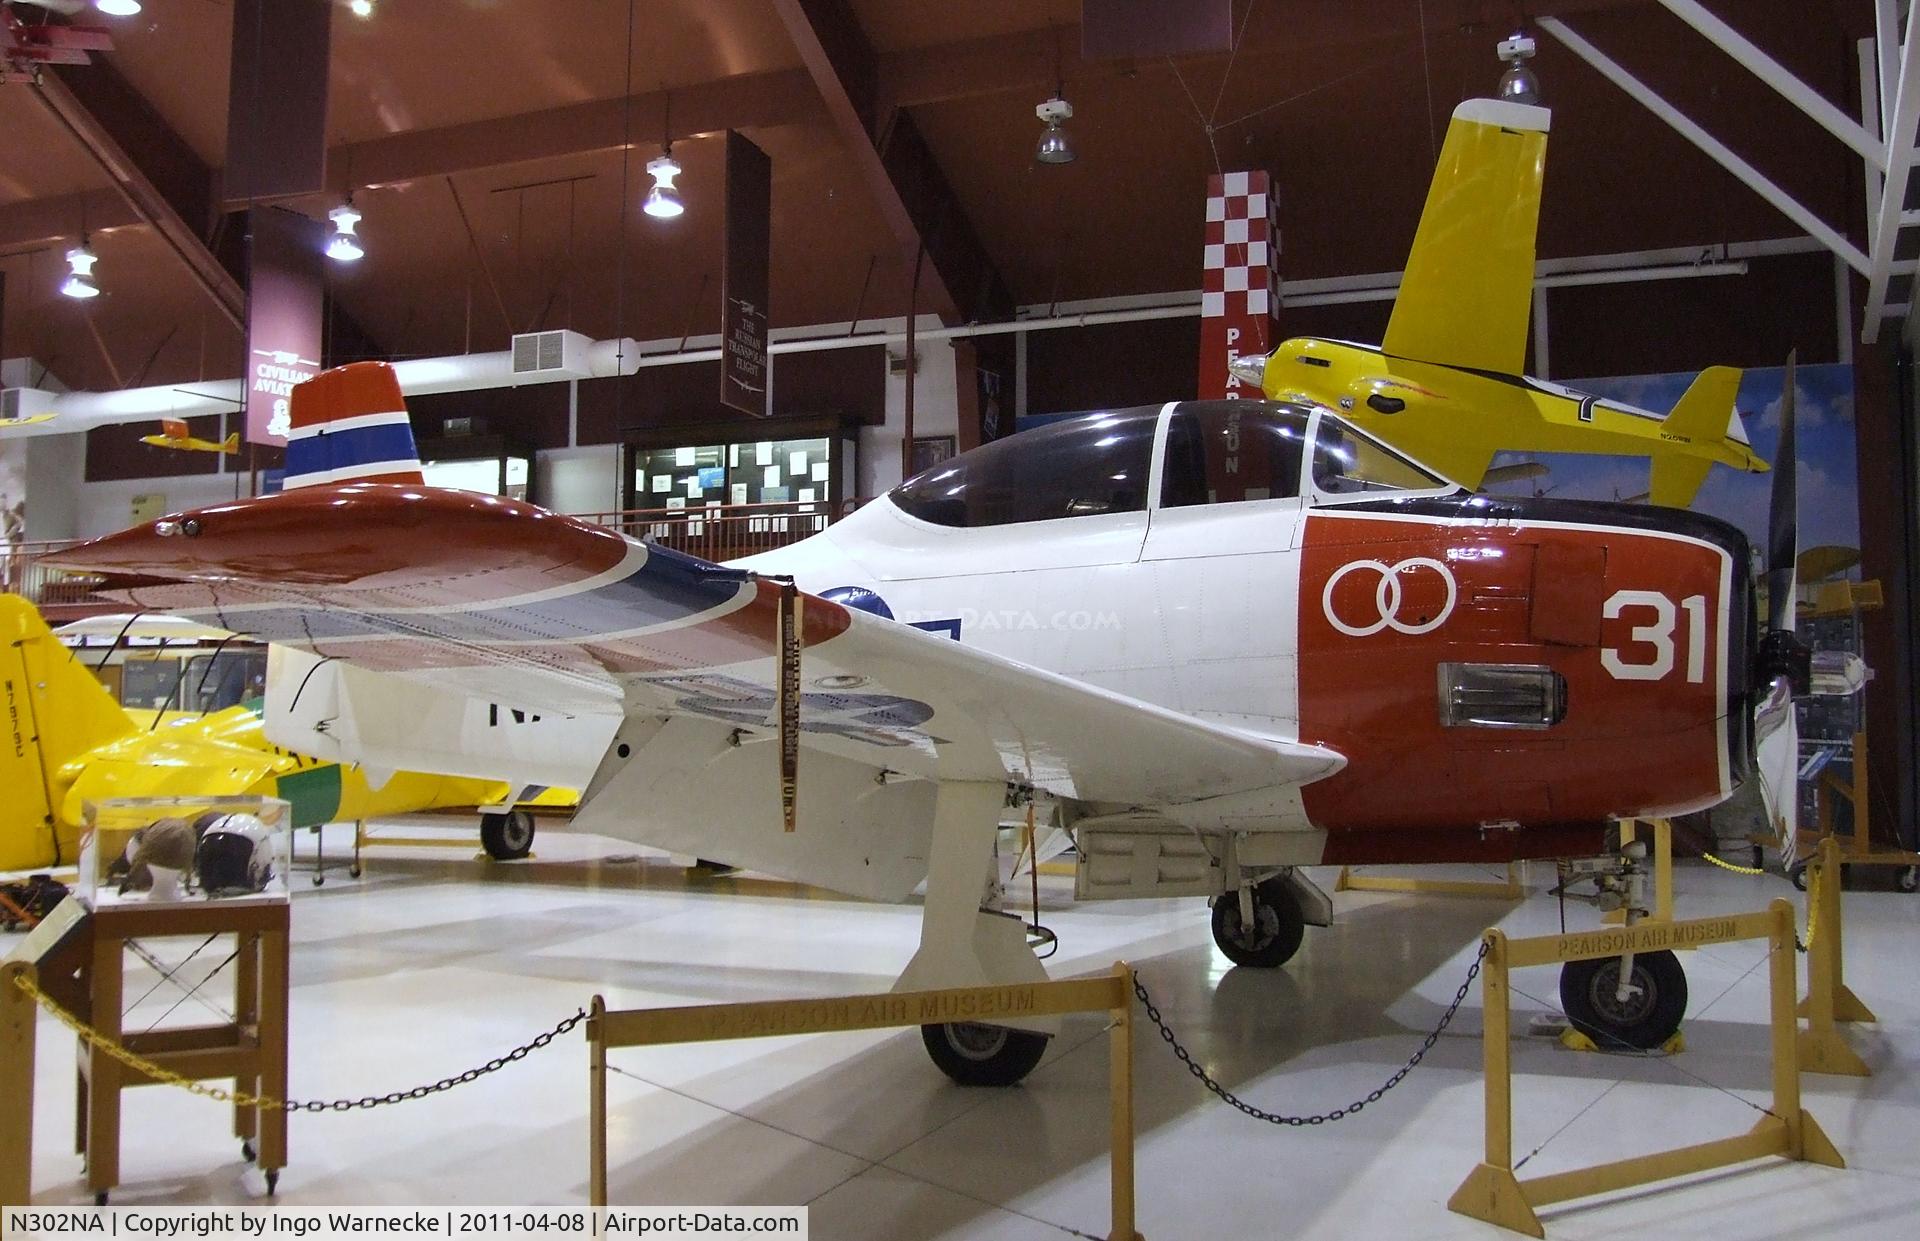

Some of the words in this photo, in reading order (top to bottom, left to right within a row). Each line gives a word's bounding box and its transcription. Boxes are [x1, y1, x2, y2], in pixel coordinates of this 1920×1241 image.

[1600, 589, 1706, 684] 31
[1558, 935, 1636, 958] PEARSON
[1641, 929, 1668, 949] AIR
[1673, 920, 1737, 944] MUSEUM
[861, 1000, 907, 1024] AIR
[919, 989, 1035, 1018] MUSEUM
